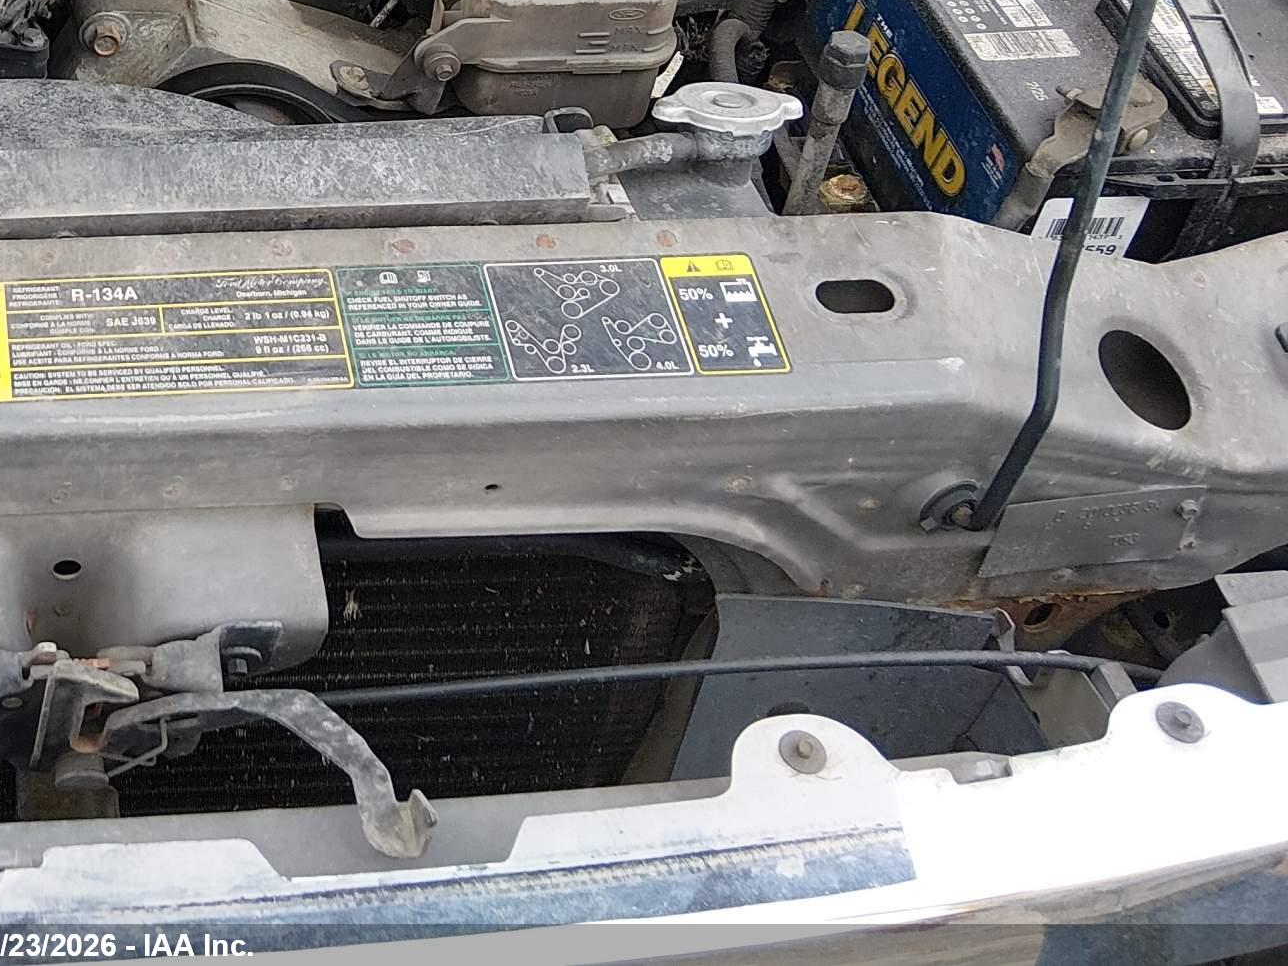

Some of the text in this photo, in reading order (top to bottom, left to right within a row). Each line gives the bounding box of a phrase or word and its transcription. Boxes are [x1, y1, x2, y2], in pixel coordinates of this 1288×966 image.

[599, 264, 622, 273] 3.0L
[71, 286, 139, 303] R-134A
[236, 289, 307, 299] Dearborn, Michigan
[347, 296, 373, 304] CHECK
[374, 295, 393, 303] FUEL
[393, 295, 426, 303] SHUTOFF
[427, 294, 456, 302] SWITCH
[679, 287, 714, 301] 50%
[348, 302, 397, 311] REFERENCED
[407, 301, 428, 309] YOUR
[428, 300, 457, 308] OWNER
[245, 312, 251, 320] 2
[253, 311, 262, 320] lb
[271, 312, 283, 320] oz
[290, 310, 313, 321] (0.94
[314, 309, 330, 320] kg)
[106, 316, 157, 327] SAE J639
[398, 321, 441, 330] COMMANDE
[453, 320, 490, 328] COUPURE
[354, 331, 367, 339] DE
[414, 328, 442, 336] COMME
[253, 334, 327, 345] WSH-M1C231-B
[356, 338, 377, 346] DANS
[378, 337, 388, 345] LE
[389, 336, 412, 345] GUIDE
[412, 336, 424, 344] DE
[12, 343, 60, 351] REFRIGERANT
[255, 345, 262, 354] 9
[272, 345, 284, 353] oz
[314, 343, 329, 354] cc)
[698, 344, 734, 358] 50%
[12, 350, 53, 358] LUBRIFIANT
[58, 349, 97, 357] CONFORME
[13, 358, 28, 366] USE
[28, 357, 53, 365] ACEITE
[54, 356, 73, 364] PARA
[73, 355, 130, 363] REFRIGERANTES
[131, 353, 170, 361] CONFORME
[176, 351, 202, 359] NORMA
[360, 359, 387, 367] REVISE
[399, 357, 451, 366] INTERRUPTOR
[464, 355, 493, 363] CIERRE
[655, 362, 680, 371] 4.0L
[14, 372, 47, 380] CAUTION:
[48, 371, 76, 379] SYSTEM
[99, 369, 134, 377] SERVICED
[134, 368, 144, 376] BY
[144, 367, 181, 375] QUALIFIED
[362, 366, 377, 374] DEL
[378, 365, 431, 373] COMBUSTIBLE
[467, 362, 493, 370] INDICA
[571, 364, 595, 373] 2.3L
[14, 380, 32, 388] MISE
[43, 378, 68, 386] GARDE
[82, 377, 114, 385] CONFIER
[115, 375, 159, 384] L'ENTRETIEN
[190, 372, 232, 380] PERSONNEL
[405, 372, 420, 380] DEL
[422, 370, 473, 379] PROPIETARIO.
[65, 385, 74, 393] EL
[75, 384, 106, 393] SISTEMA
[107, 383, 125, 391] DEBE
[142, 382, 176, 390] ATENDIDO
[177, 381, 198, 389] SOLO
[198, 380, 214, 388] POR
[215, 379, 251, 387] PERSONAL
